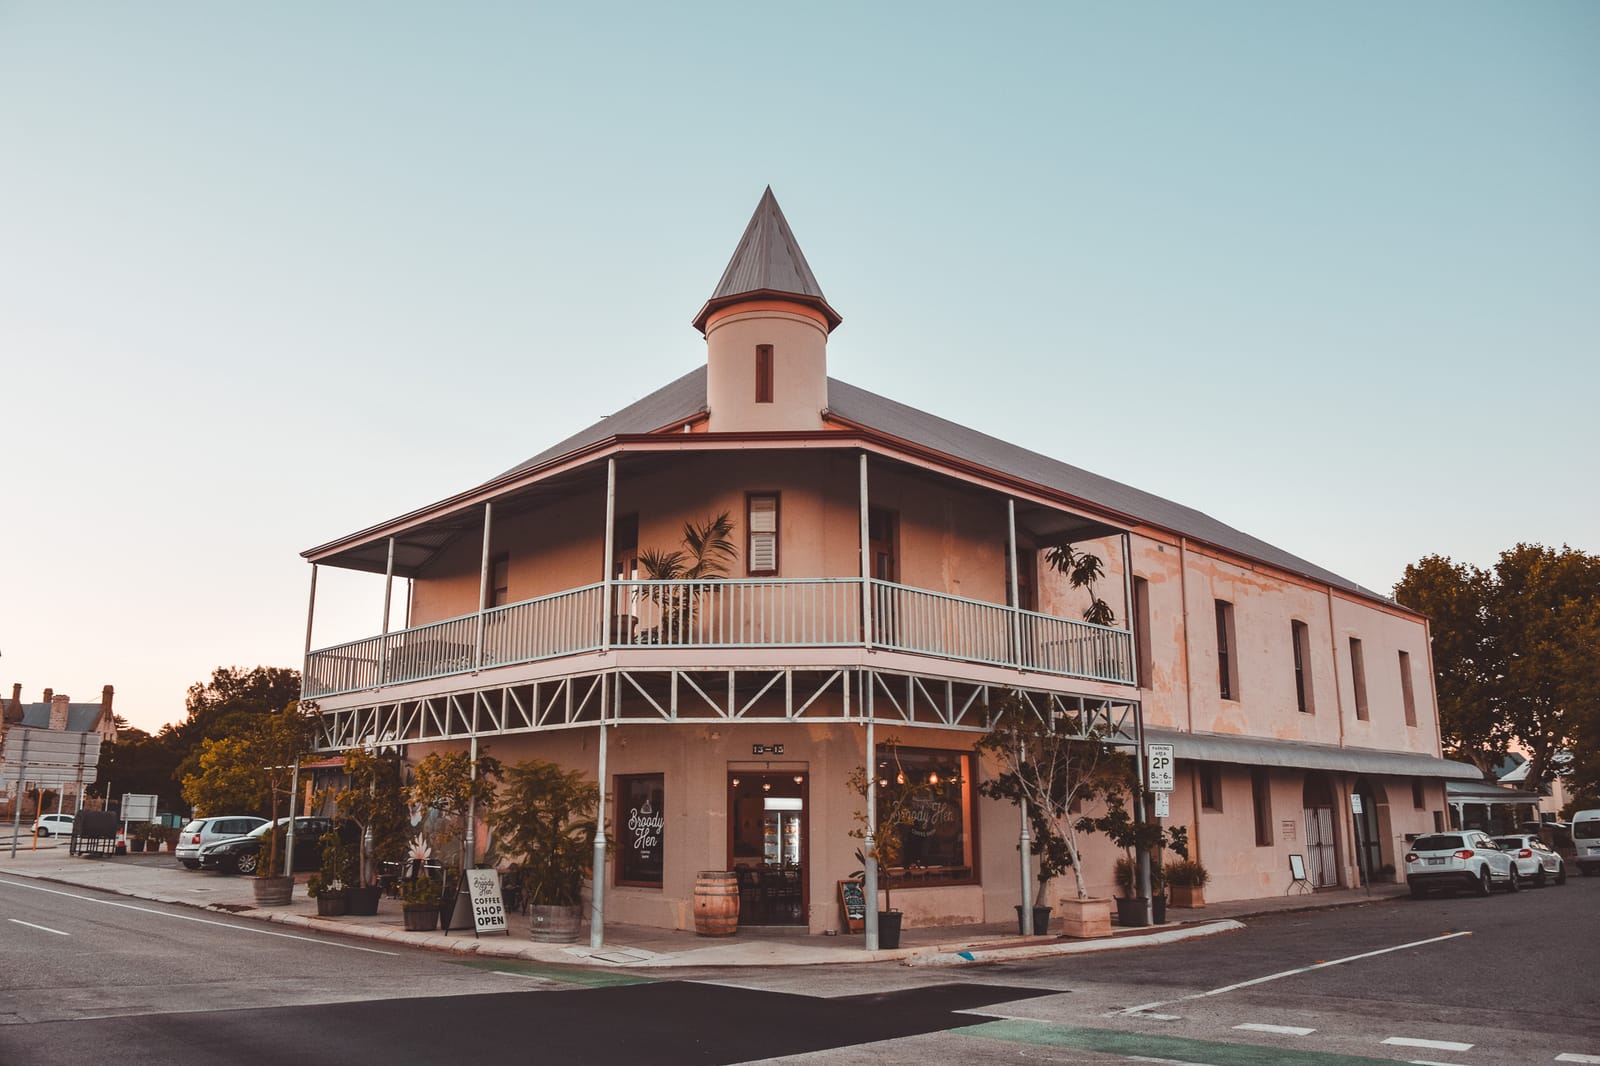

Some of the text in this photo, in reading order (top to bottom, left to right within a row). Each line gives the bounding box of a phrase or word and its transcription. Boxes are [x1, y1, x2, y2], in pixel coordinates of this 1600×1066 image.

[1153, 757, 1170, 769] 2P
[931, 802, 955, 825] Hen
[628, 807, 665, 834] Broody
[633, 827, 657, 849] Hen
[474, 897, 501, 905] COFFEE
[476, 905, 502, 915] SHOP
[477, 916, 504, 926] OPEN
